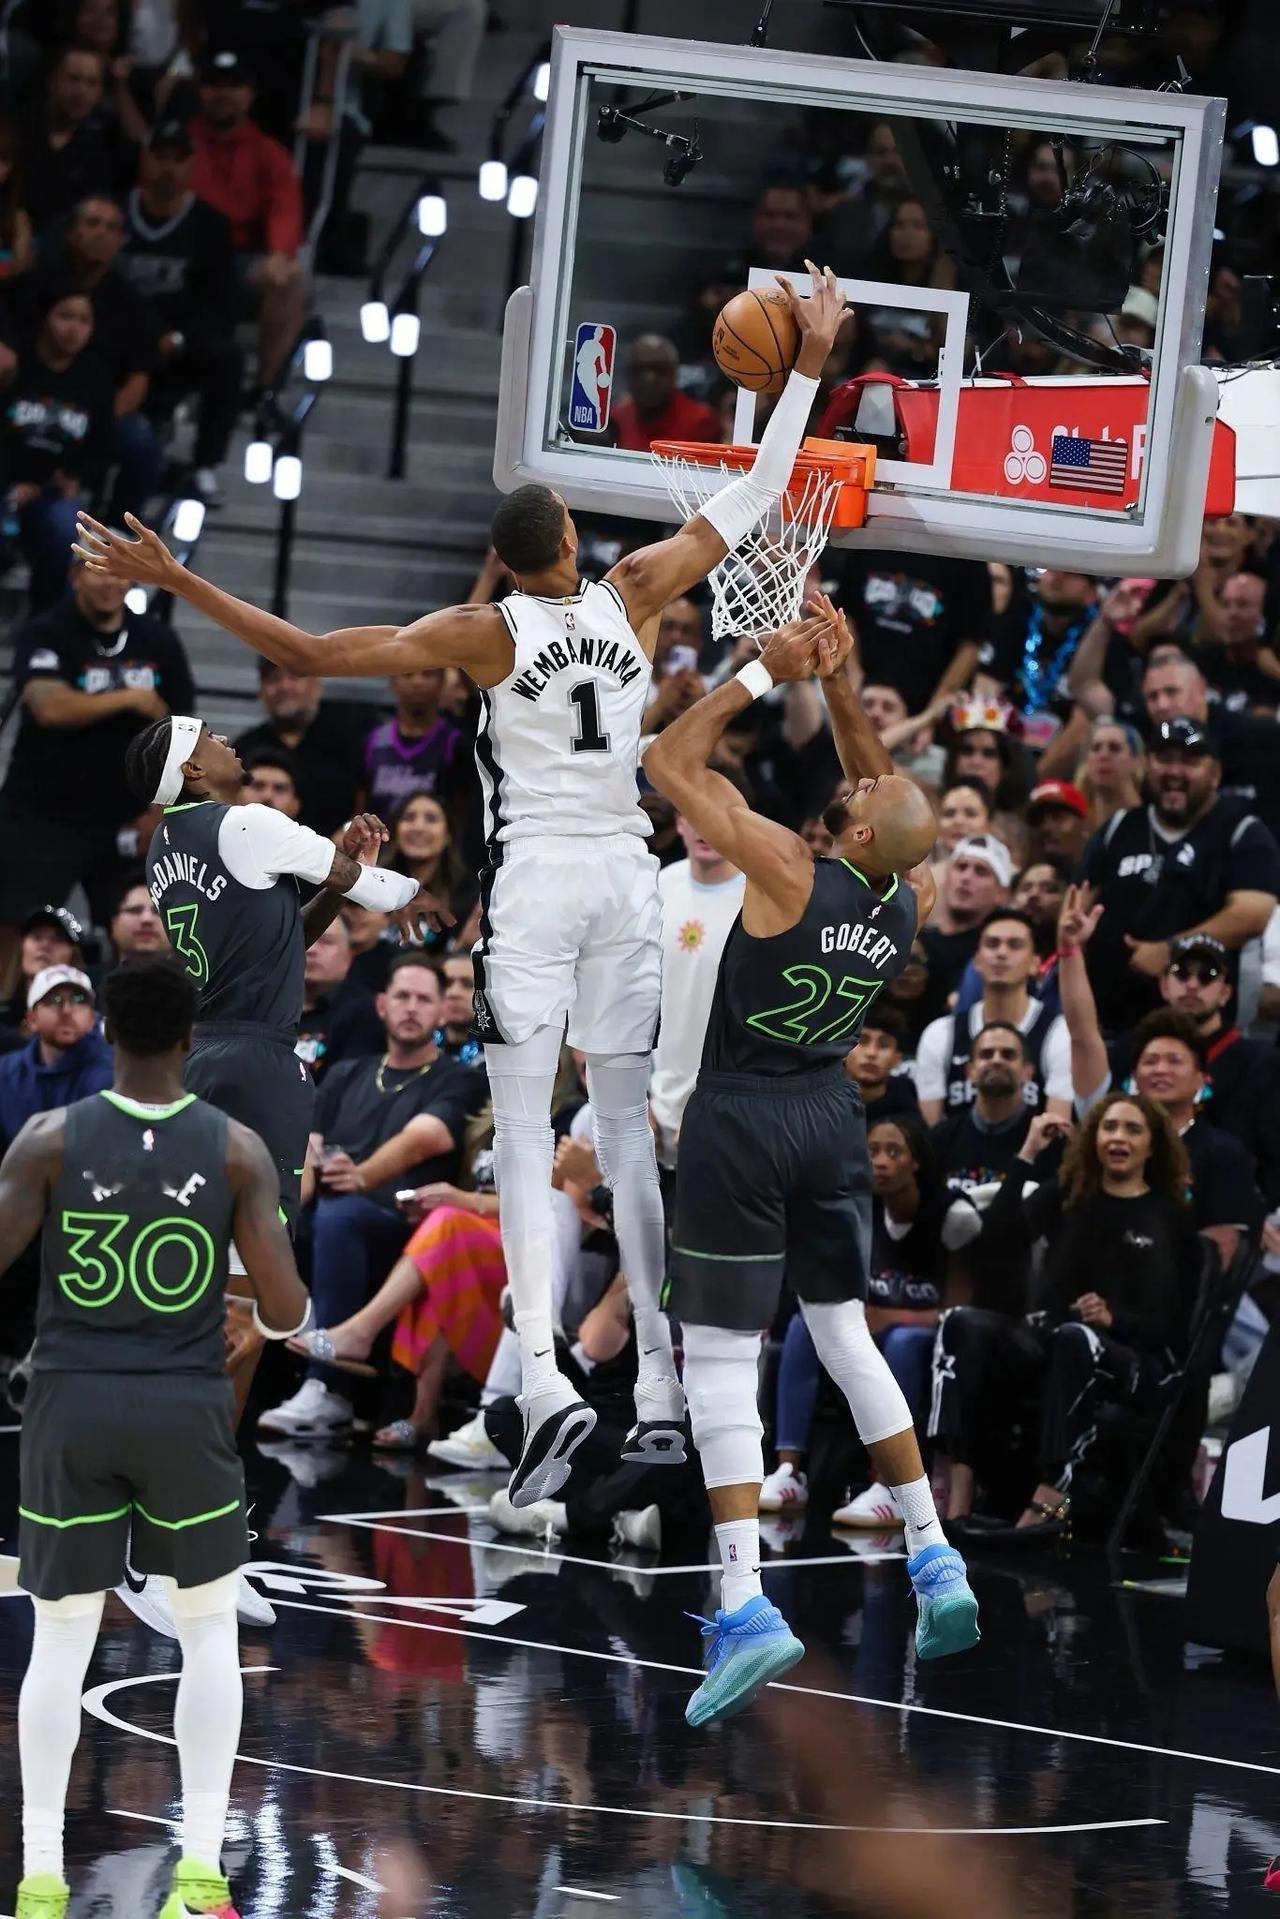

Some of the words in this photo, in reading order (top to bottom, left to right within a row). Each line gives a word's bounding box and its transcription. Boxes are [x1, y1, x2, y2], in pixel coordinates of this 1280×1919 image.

[574, 406, 593, 424] NBA
[511, 637, 642, 702] WEMBANYAMA
[567, 677, 612, 753] 1
[167, 903, 209, 983] 3
[820, 923, 898, 970] GOBERT
[746, 964, 884, 1045] 27
[58, 1210, 215, 1313] 30
